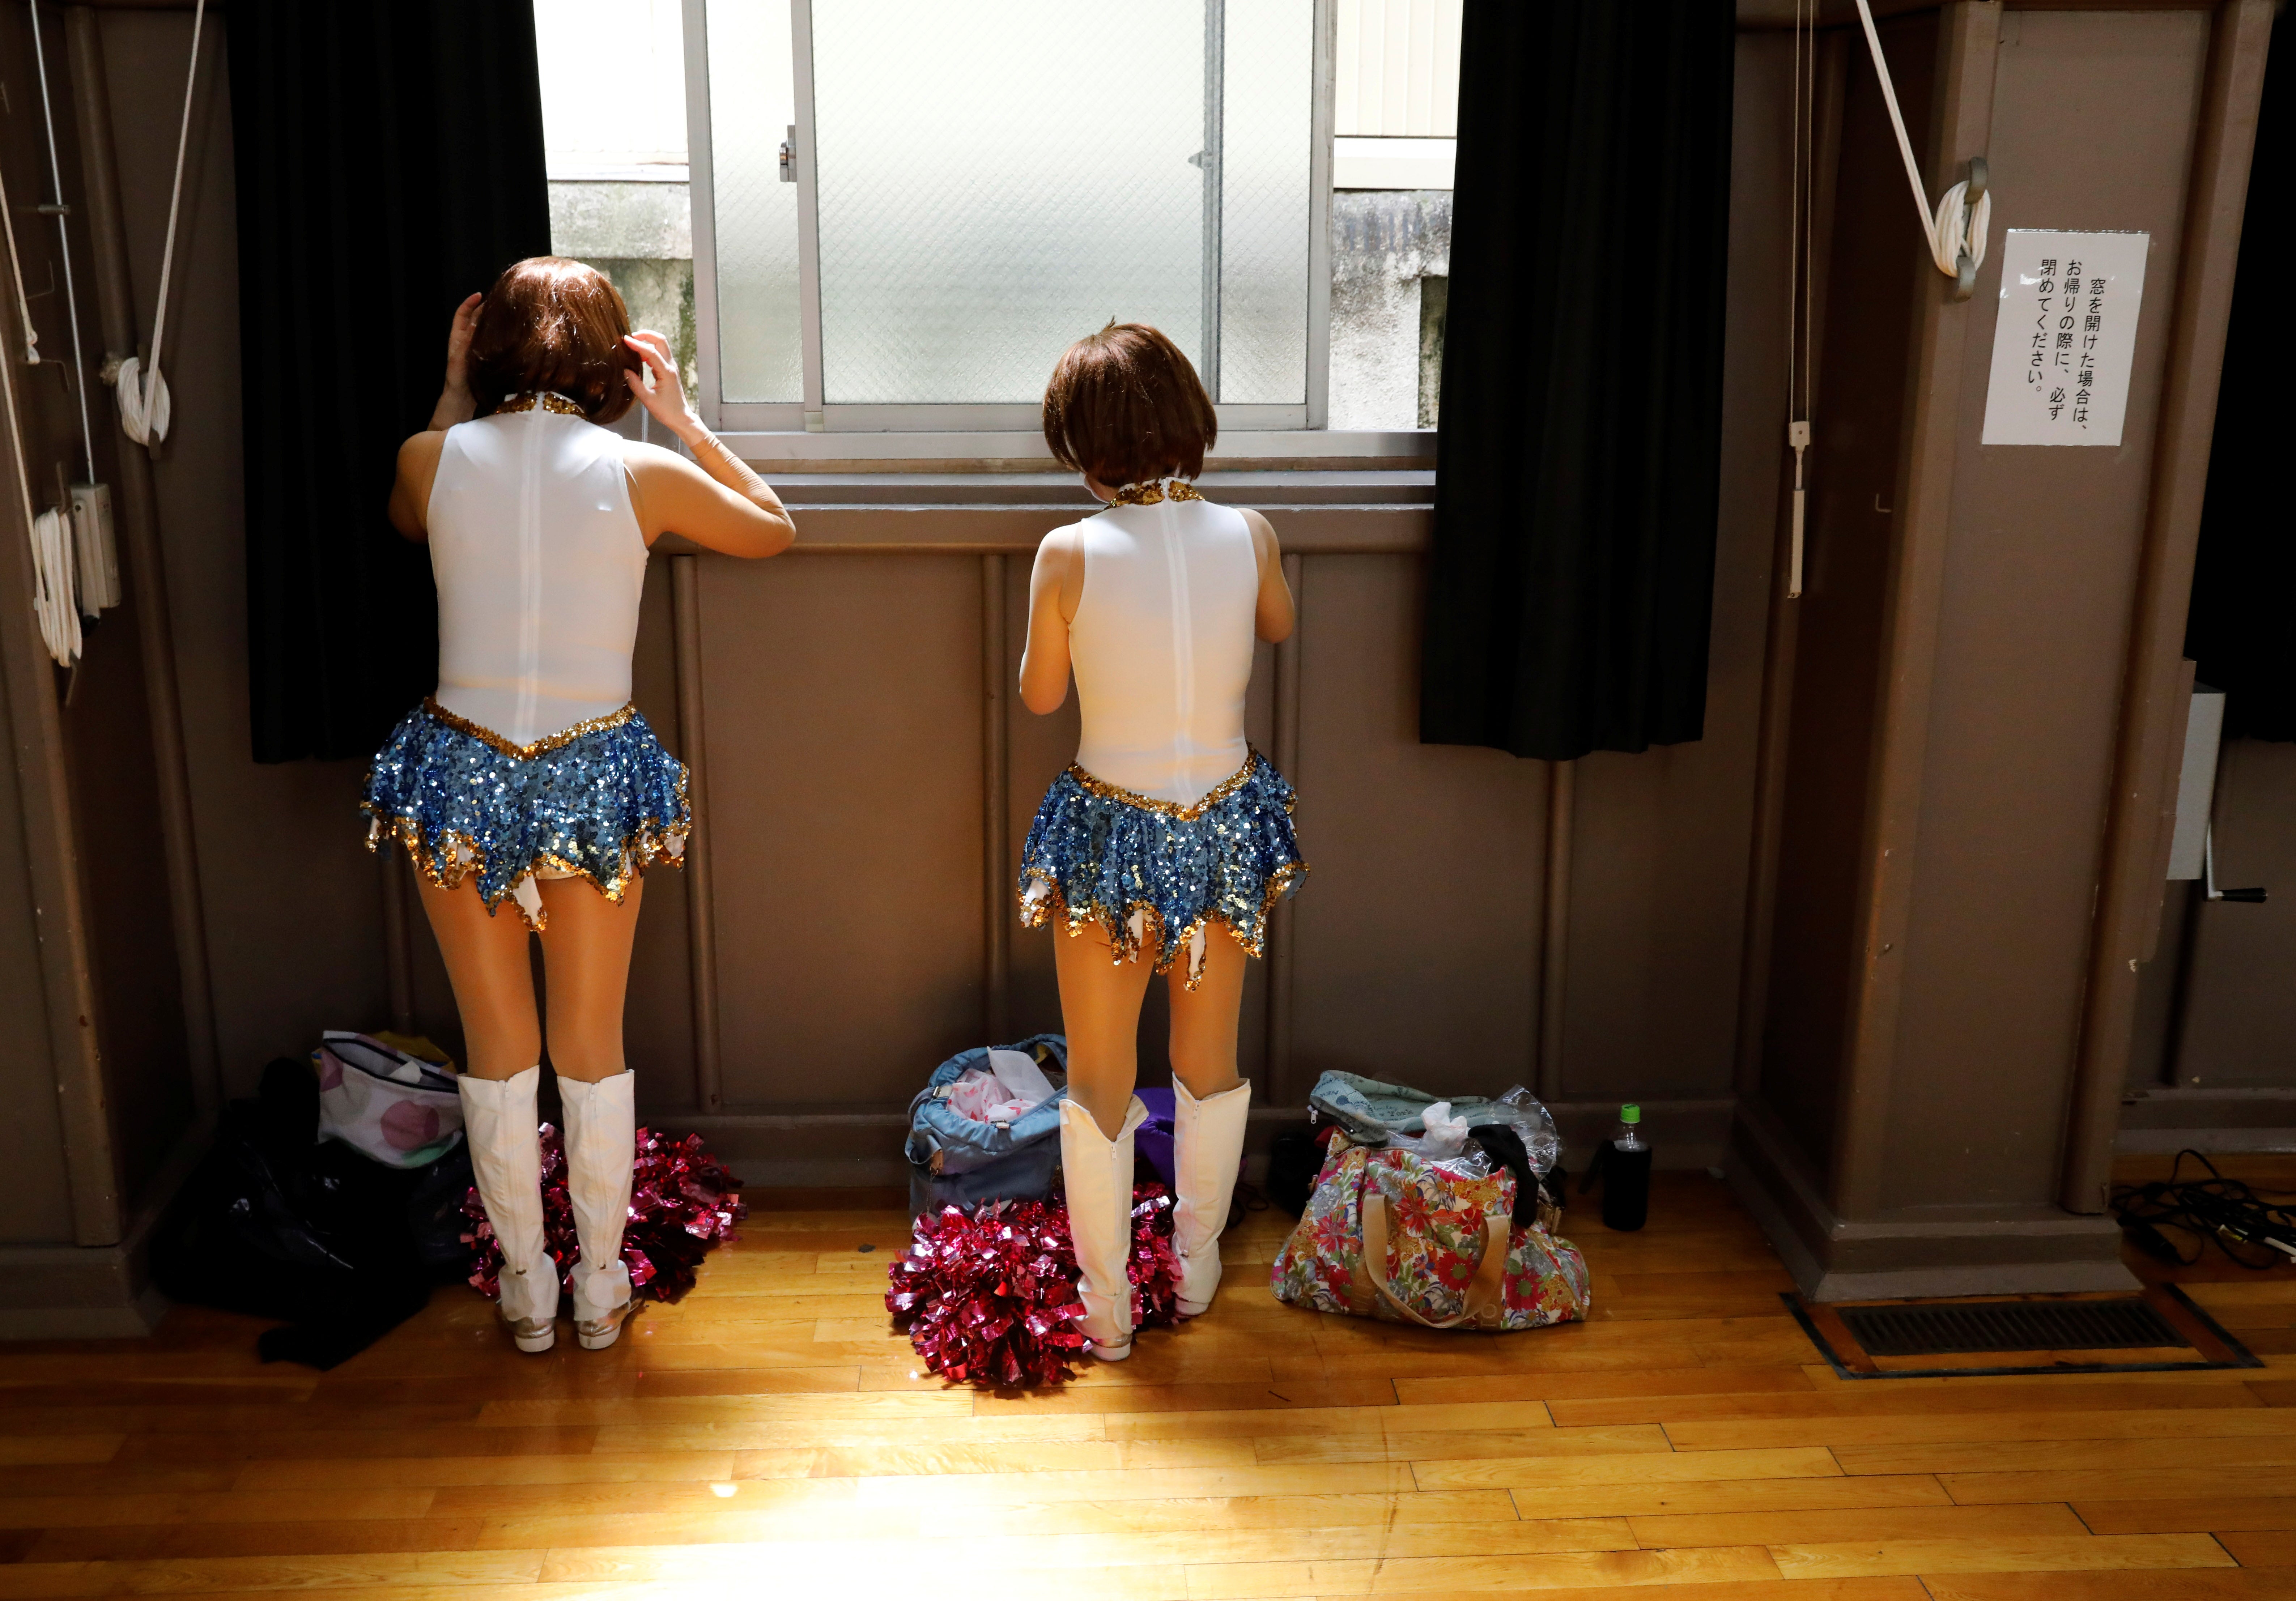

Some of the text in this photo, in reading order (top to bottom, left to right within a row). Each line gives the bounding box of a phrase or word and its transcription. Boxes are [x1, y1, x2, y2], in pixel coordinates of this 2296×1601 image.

[2028, 259, 2057, 392] 閉めてください。
[2048, 259, 2082, 421] お帰りの際に、必ず
[2073, 278, 2106, 430] 窓を開けた場合は、
